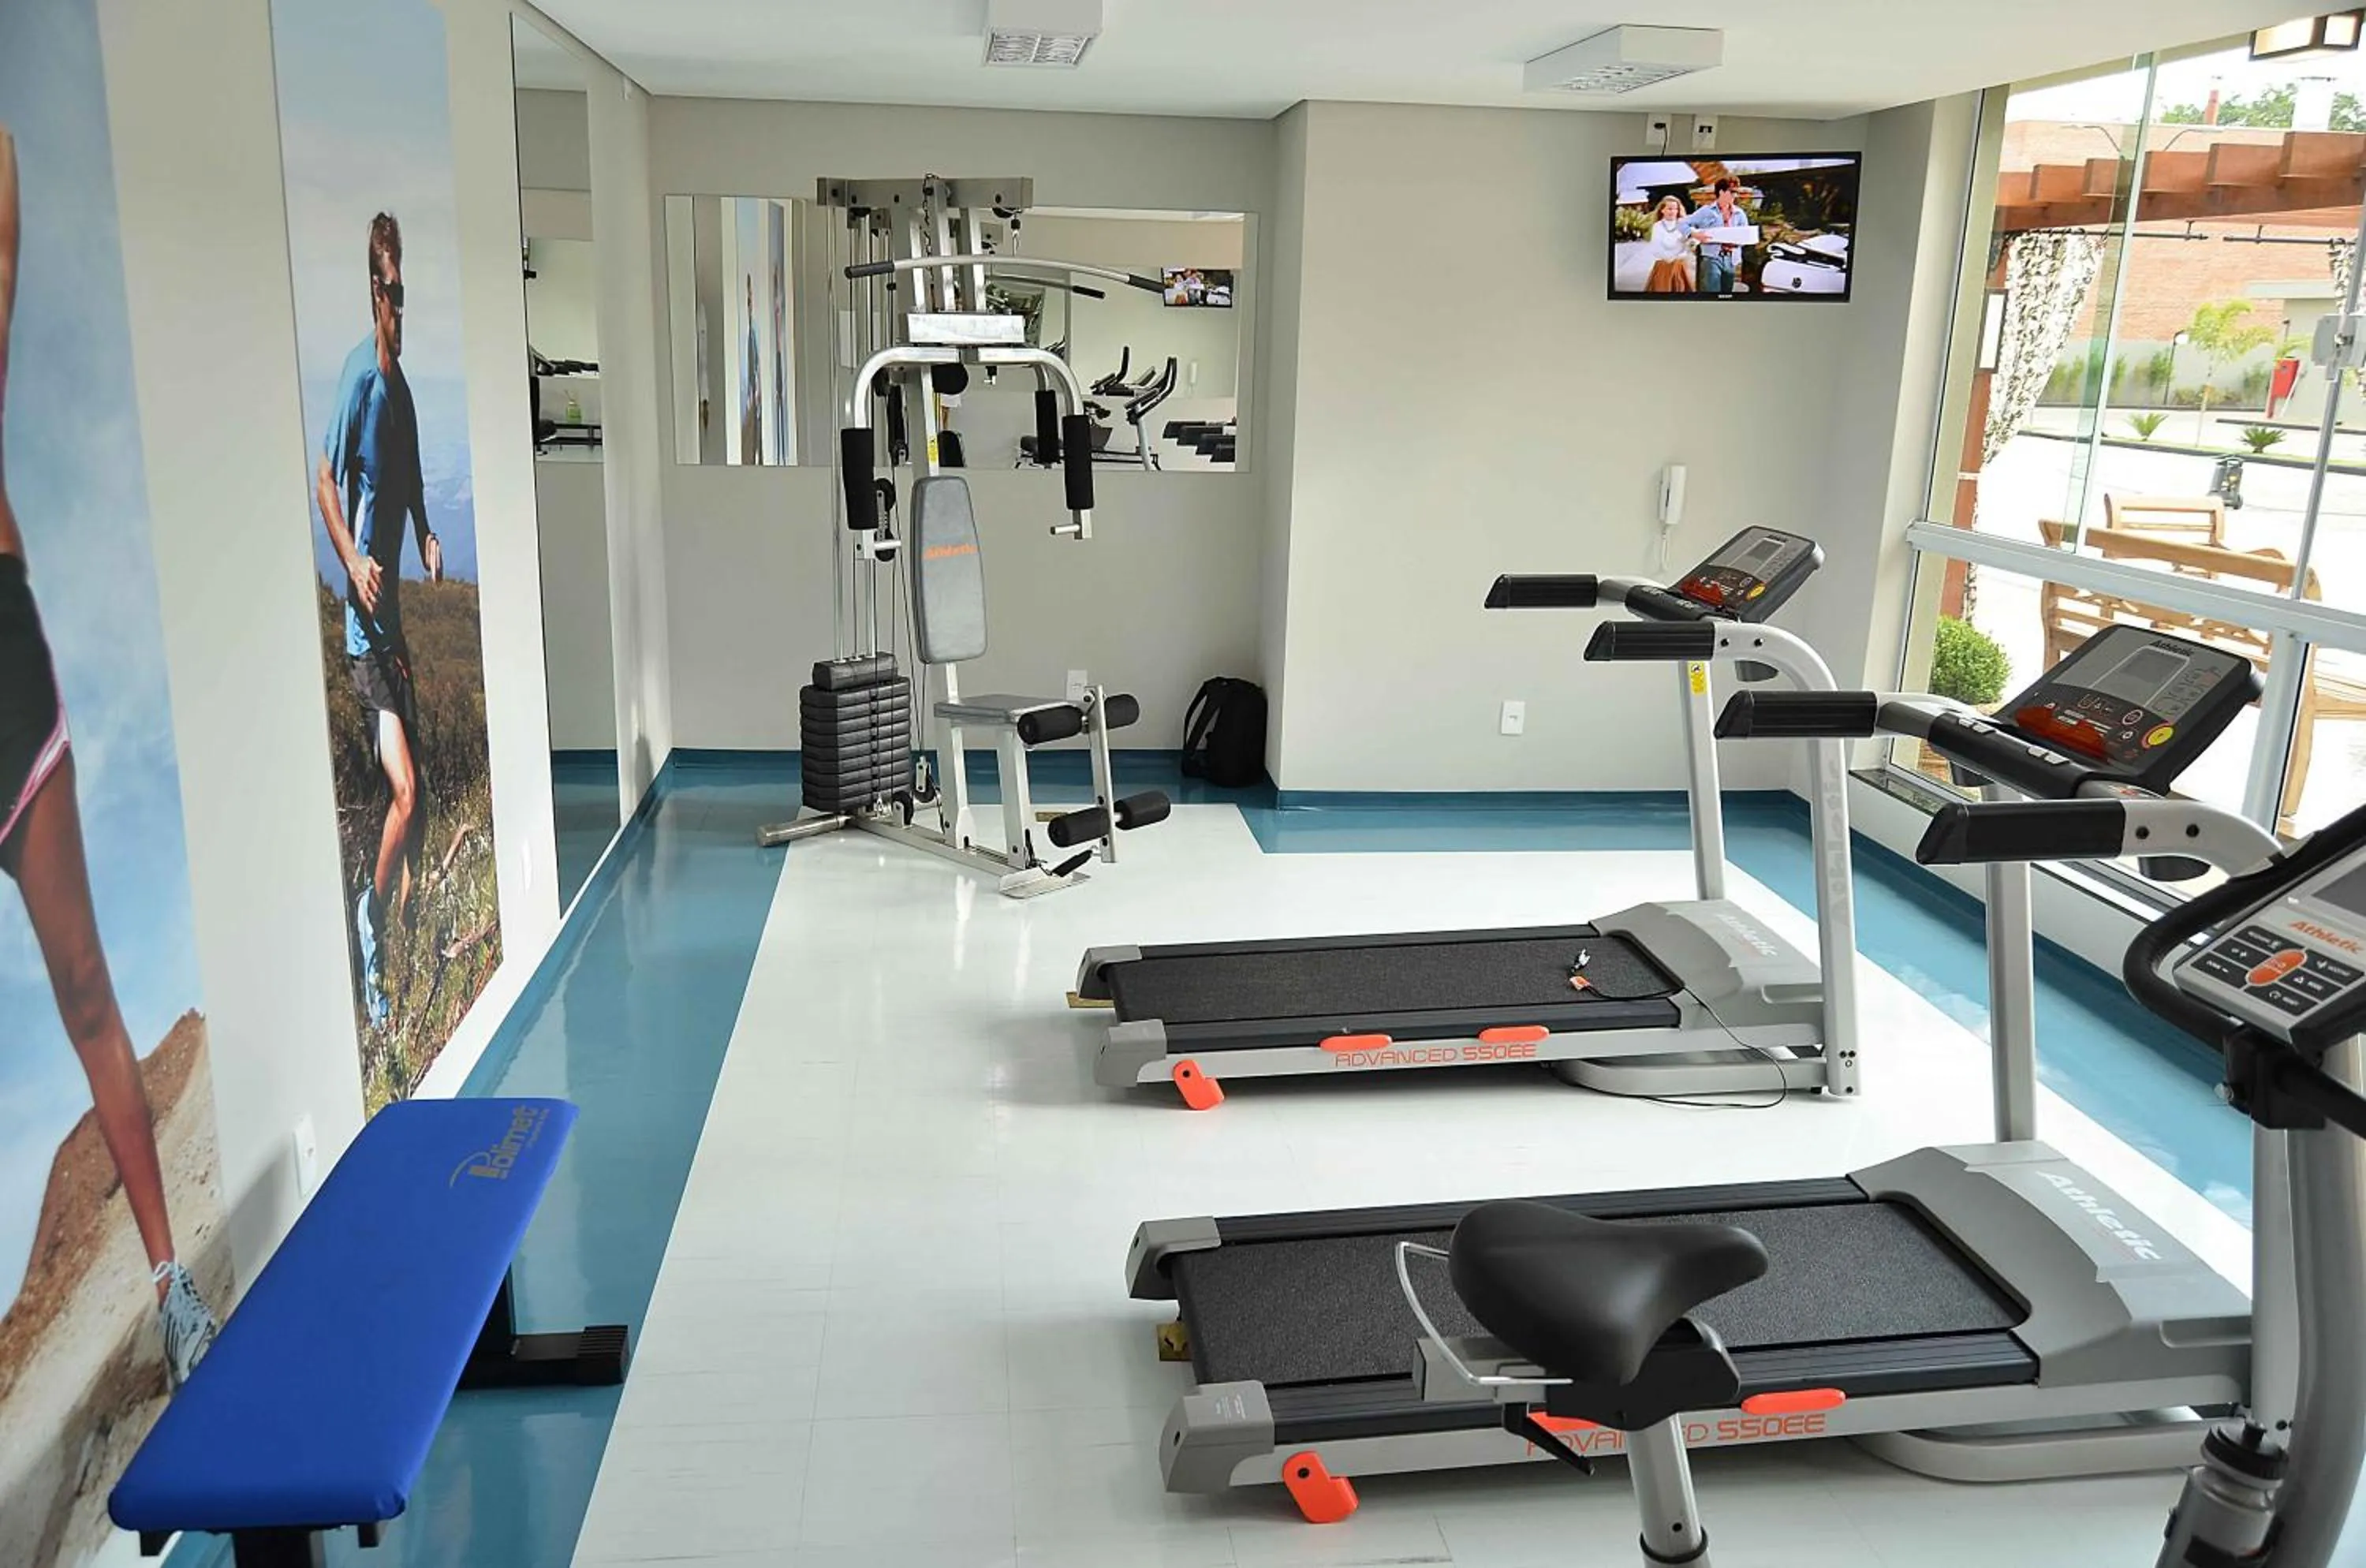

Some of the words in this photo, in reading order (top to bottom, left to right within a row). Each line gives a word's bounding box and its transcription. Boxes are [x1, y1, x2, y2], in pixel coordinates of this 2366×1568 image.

[2289, 920, 2364, 954] Athletic
[1335, 1047, 1457, 1067] ADVANCED
[2036, 1170, 2163, 1260] Athletic
